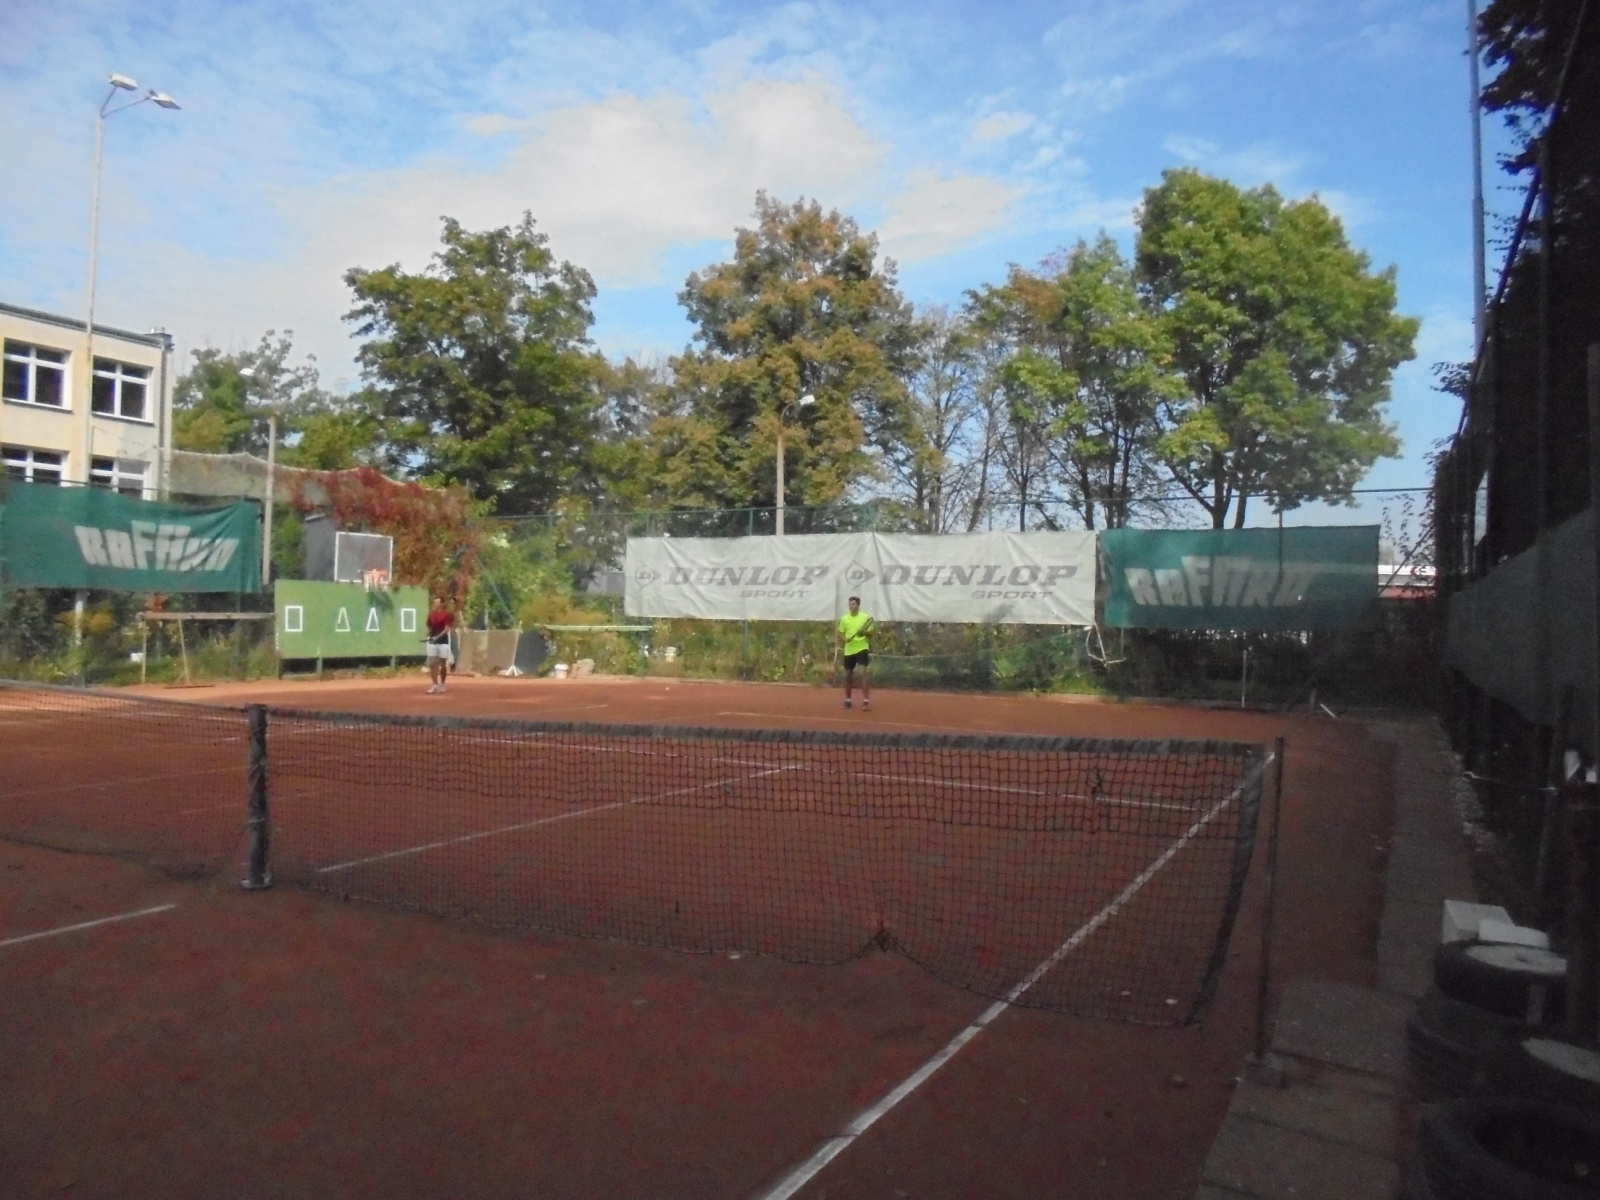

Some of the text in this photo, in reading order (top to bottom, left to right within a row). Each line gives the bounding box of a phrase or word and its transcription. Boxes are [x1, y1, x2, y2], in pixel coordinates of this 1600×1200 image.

[664, 566, 829, 586] DUNLOP
[879, 565, 1078, 586] DUNLOP
[740, 590, 809, 598] SPORT
[971, 590, 1053, 600] SPORT
